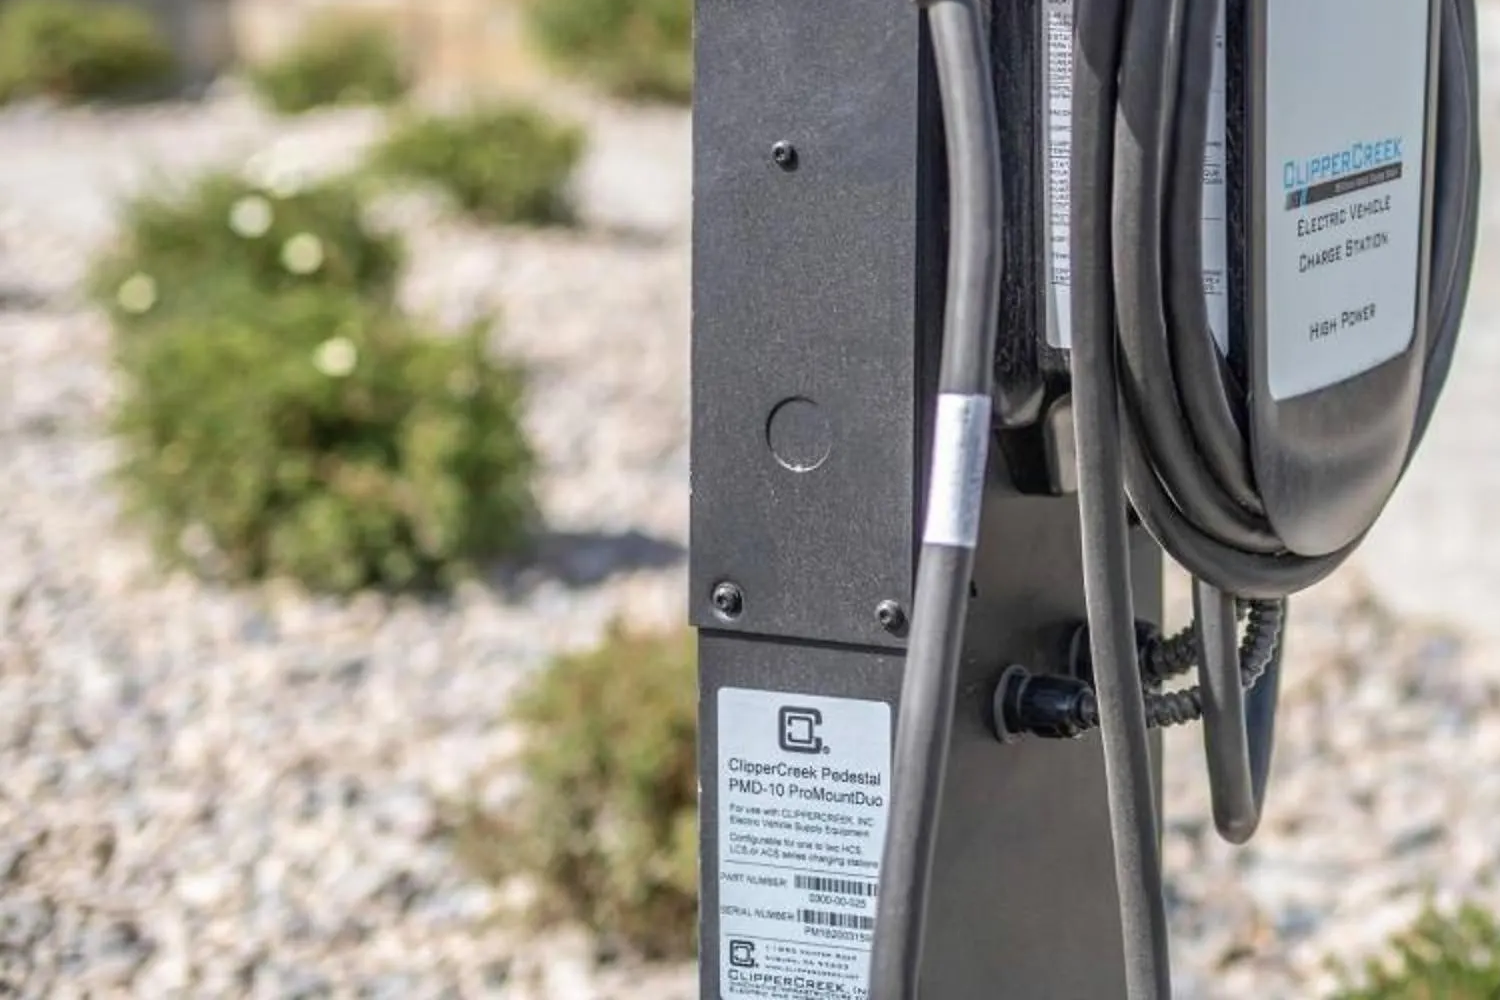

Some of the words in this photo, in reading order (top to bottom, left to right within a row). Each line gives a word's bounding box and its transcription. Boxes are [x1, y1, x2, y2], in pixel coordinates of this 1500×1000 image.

[1297, 208, 1347, 238] ELECTRIC
[1349, 194, 1392, 221] VEHICLE
[1298, 246, 1342, 273] CHARGE
[1346, 232, 1389, 257] STATION
[1309, 316, 1337, 341] HIGH
[1341, 303, 1376, 329] POWER
[728, 757, 817, 779] ClipperCreek
[821, 767, 881, 786] Pedestal
[728, 778, 785, 797] PMD-10
[789, 784, 883, 807] ProMountDuo
